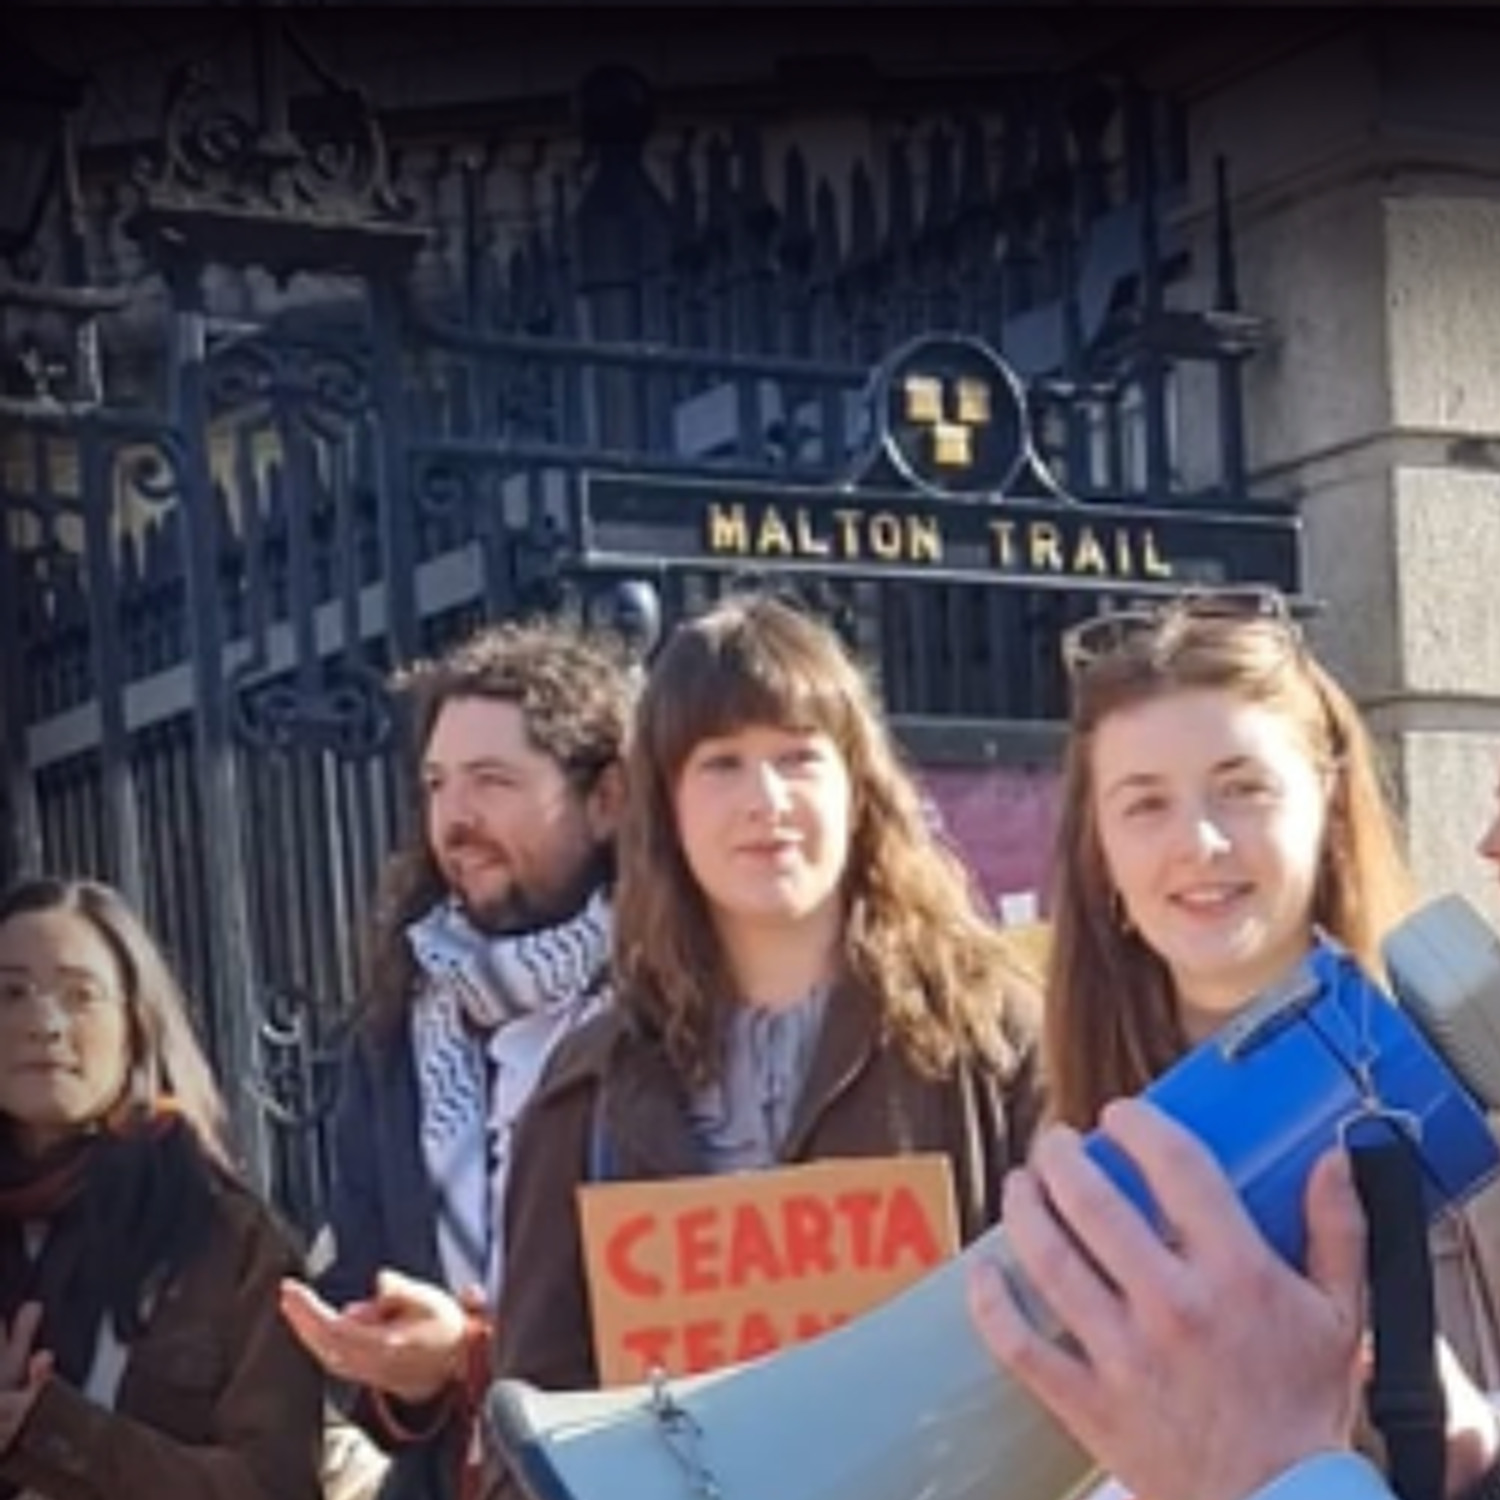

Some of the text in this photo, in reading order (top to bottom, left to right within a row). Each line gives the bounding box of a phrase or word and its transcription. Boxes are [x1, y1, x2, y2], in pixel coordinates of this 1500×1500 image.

[708, 503, 1173, 577] MALTON TRAIL
[603, 1187, 942, 1298] CEARTA
